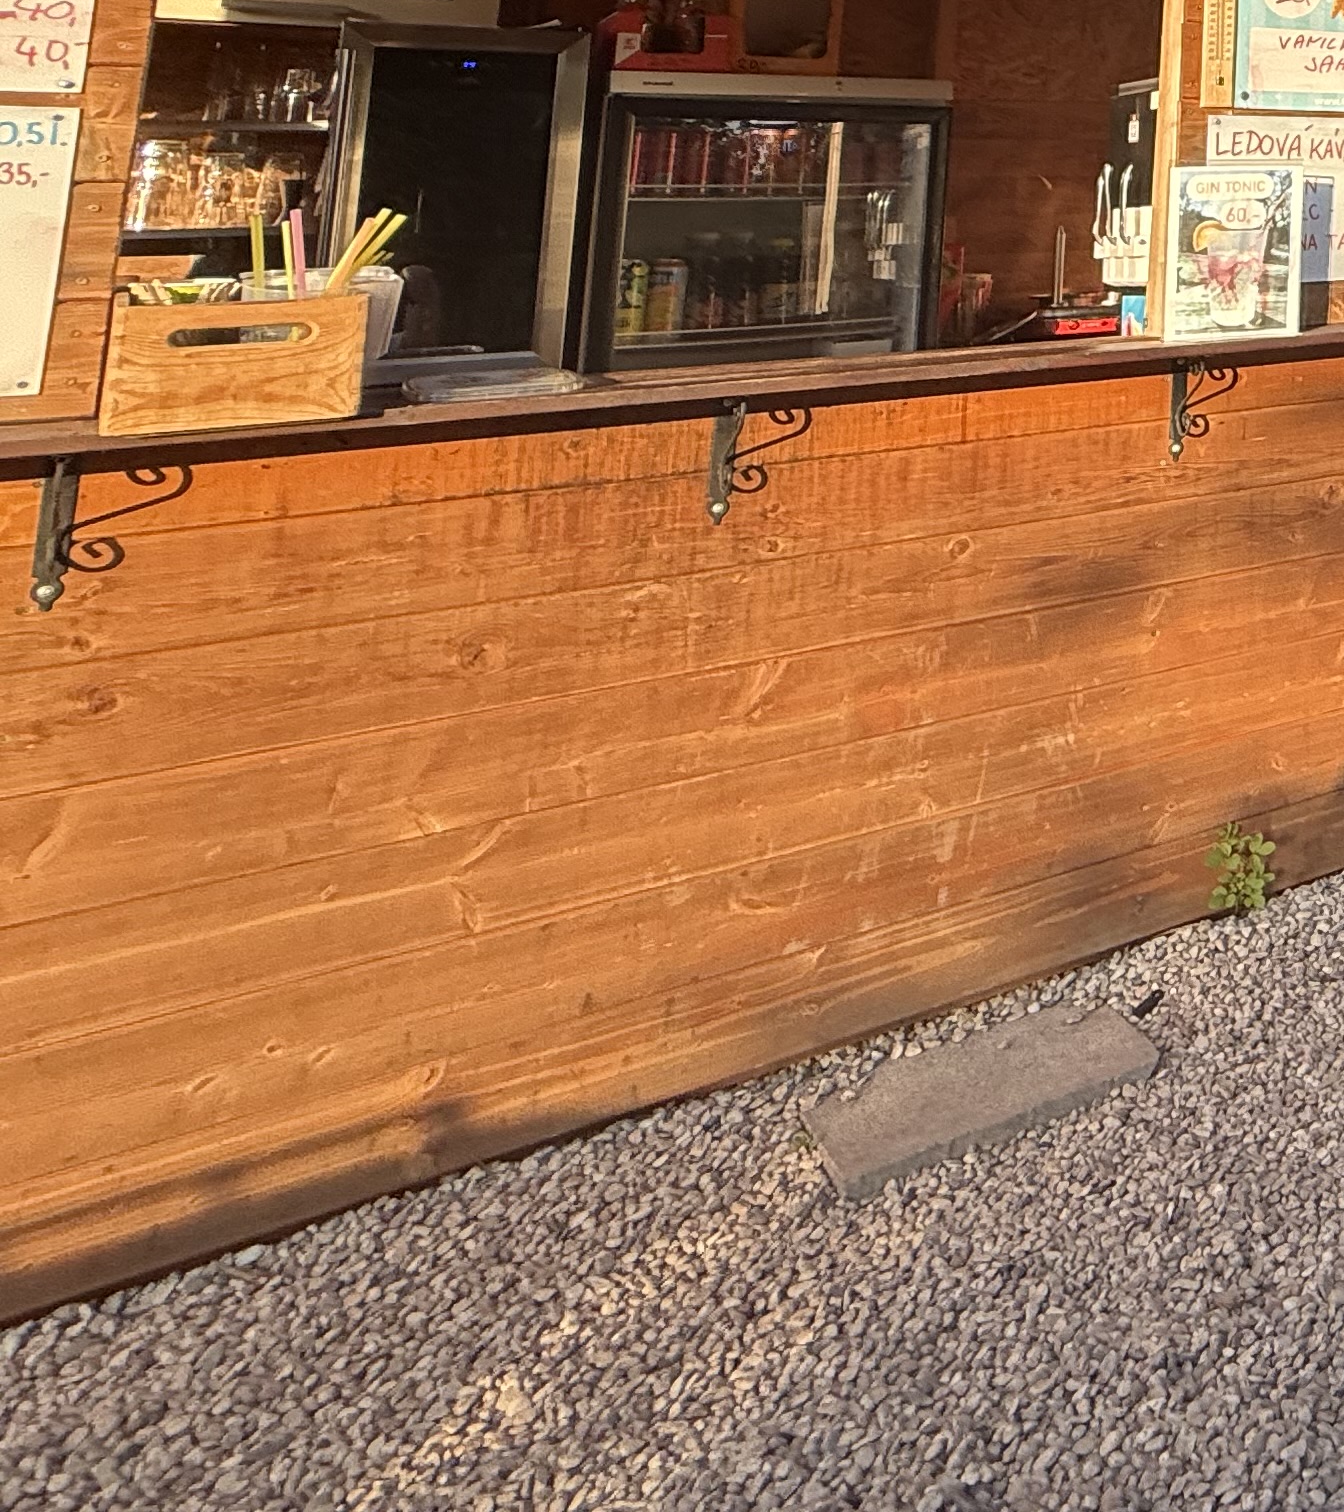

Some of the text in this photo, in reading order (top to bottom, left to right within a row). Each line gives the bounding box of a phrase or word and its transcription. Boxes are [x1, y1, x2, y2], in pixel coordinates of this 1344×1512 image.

[15, 36, 89, 71] 40,-
[1214, 124, 1314, 160] LEDOVÁ
[0, 161, 50, 188] 35,-
[1195, 180, 1266, 195] GIN TONIC
